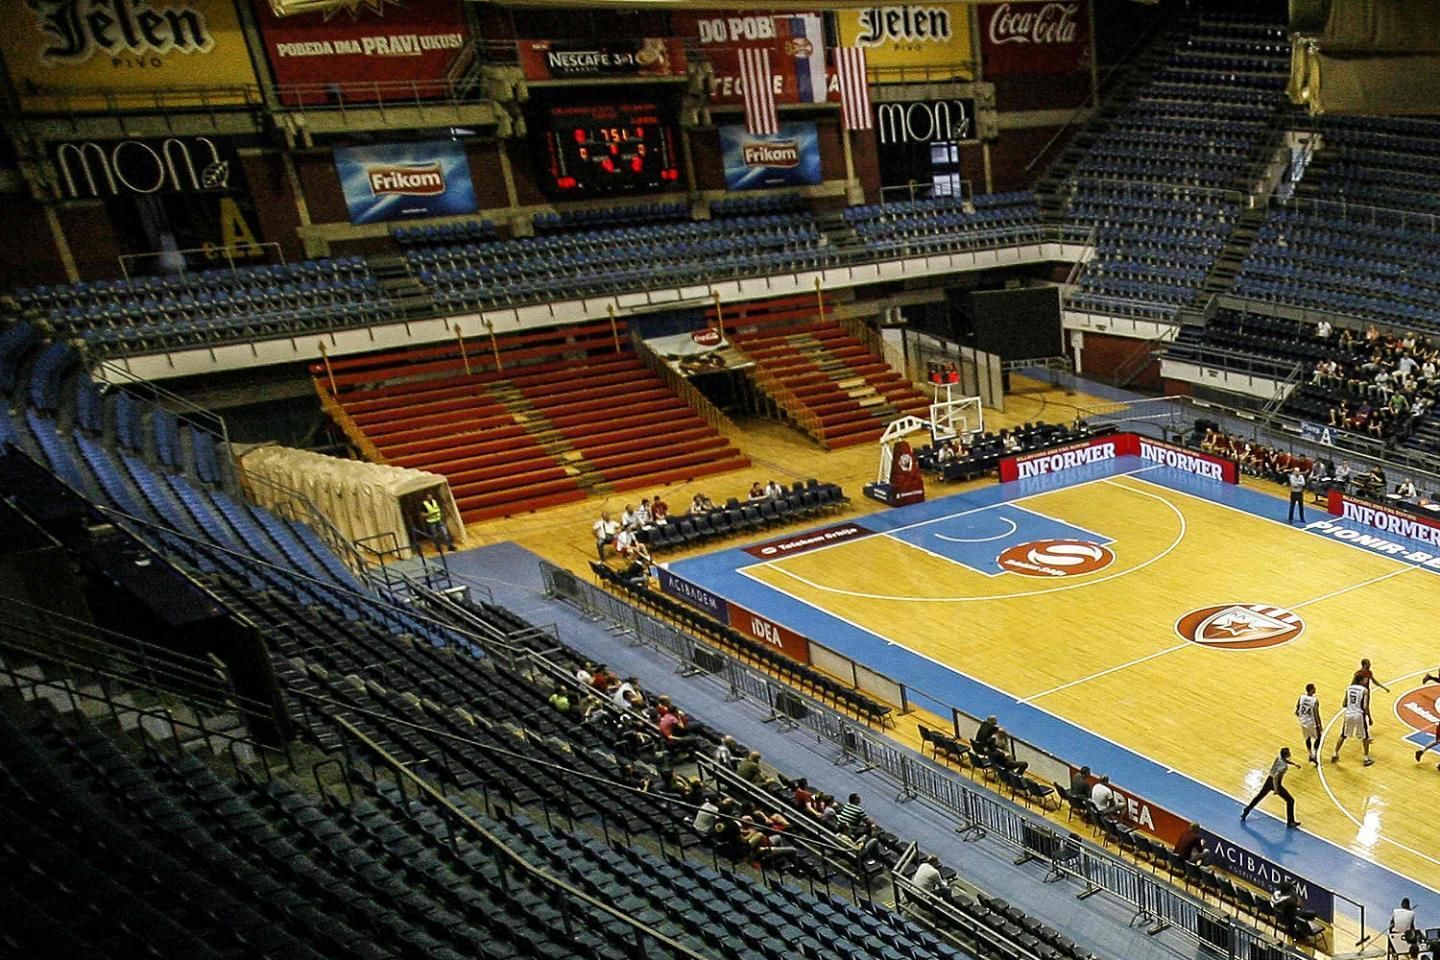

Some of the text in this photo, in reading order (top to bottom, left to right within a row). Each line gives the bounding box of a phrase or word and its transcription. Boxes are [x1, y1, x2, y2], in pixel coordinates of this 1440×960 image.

[699, 19, 726, 43] DO
[990, 4, 1078, 44] Coca-Cola
[360, 34, 421, 56] PRAVI
[419, 33, 462, 50] UKUS!
[111, 57, 163, 68] PIVO
[746, 147, 796, 163] Frikom
[371, 171, 440, 190] Frikom
[1017, 442, 1116, 480] INFORMER
[1140, 441, 1223, 481] INFORMER
[668, 577, 717, 609] ACIBADEM
[1113, 790, 1154, 831] DEA
